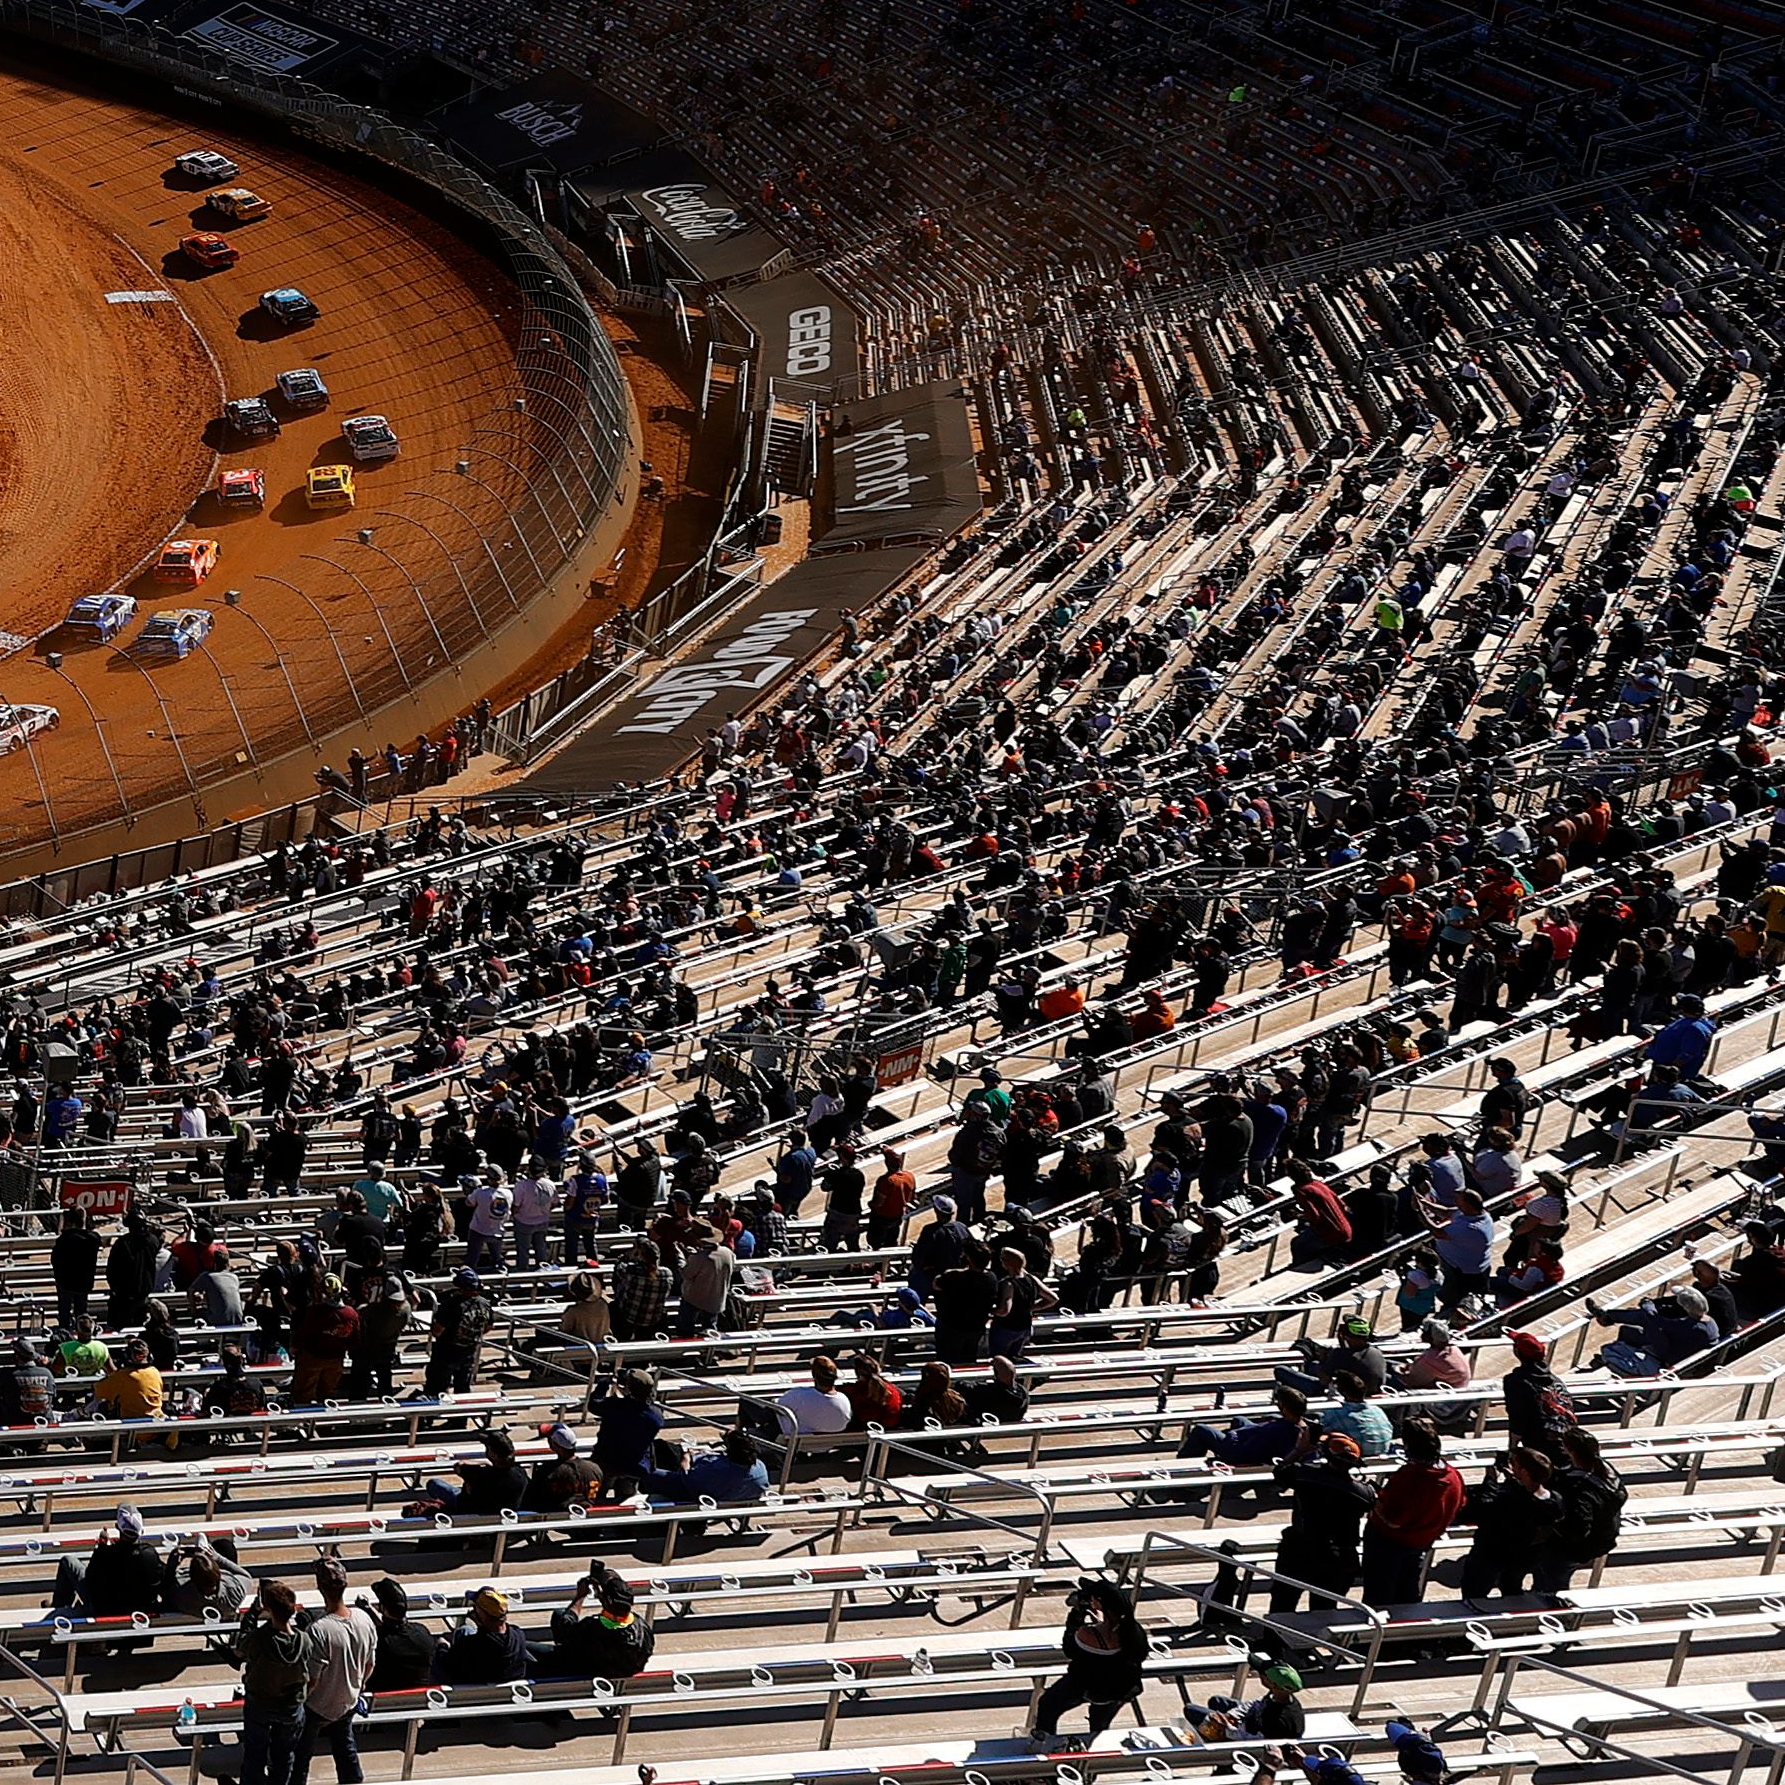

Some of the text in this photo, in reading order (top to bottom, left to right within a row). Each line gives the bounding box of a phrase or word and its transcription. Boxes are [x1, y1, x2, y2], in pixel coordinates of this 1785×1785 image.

[235, 35, 291, 65] SERIES
[251, 18, 317, 51] NASCAR
[494, 101, 579, 147] BUSCH
[786, 305, 831, 376] GEICO
[833, 418, 930, 514] xfinity
[612, 608, 820, 737] FOOD CITY
[77, 1189, 117, 1209] ON
